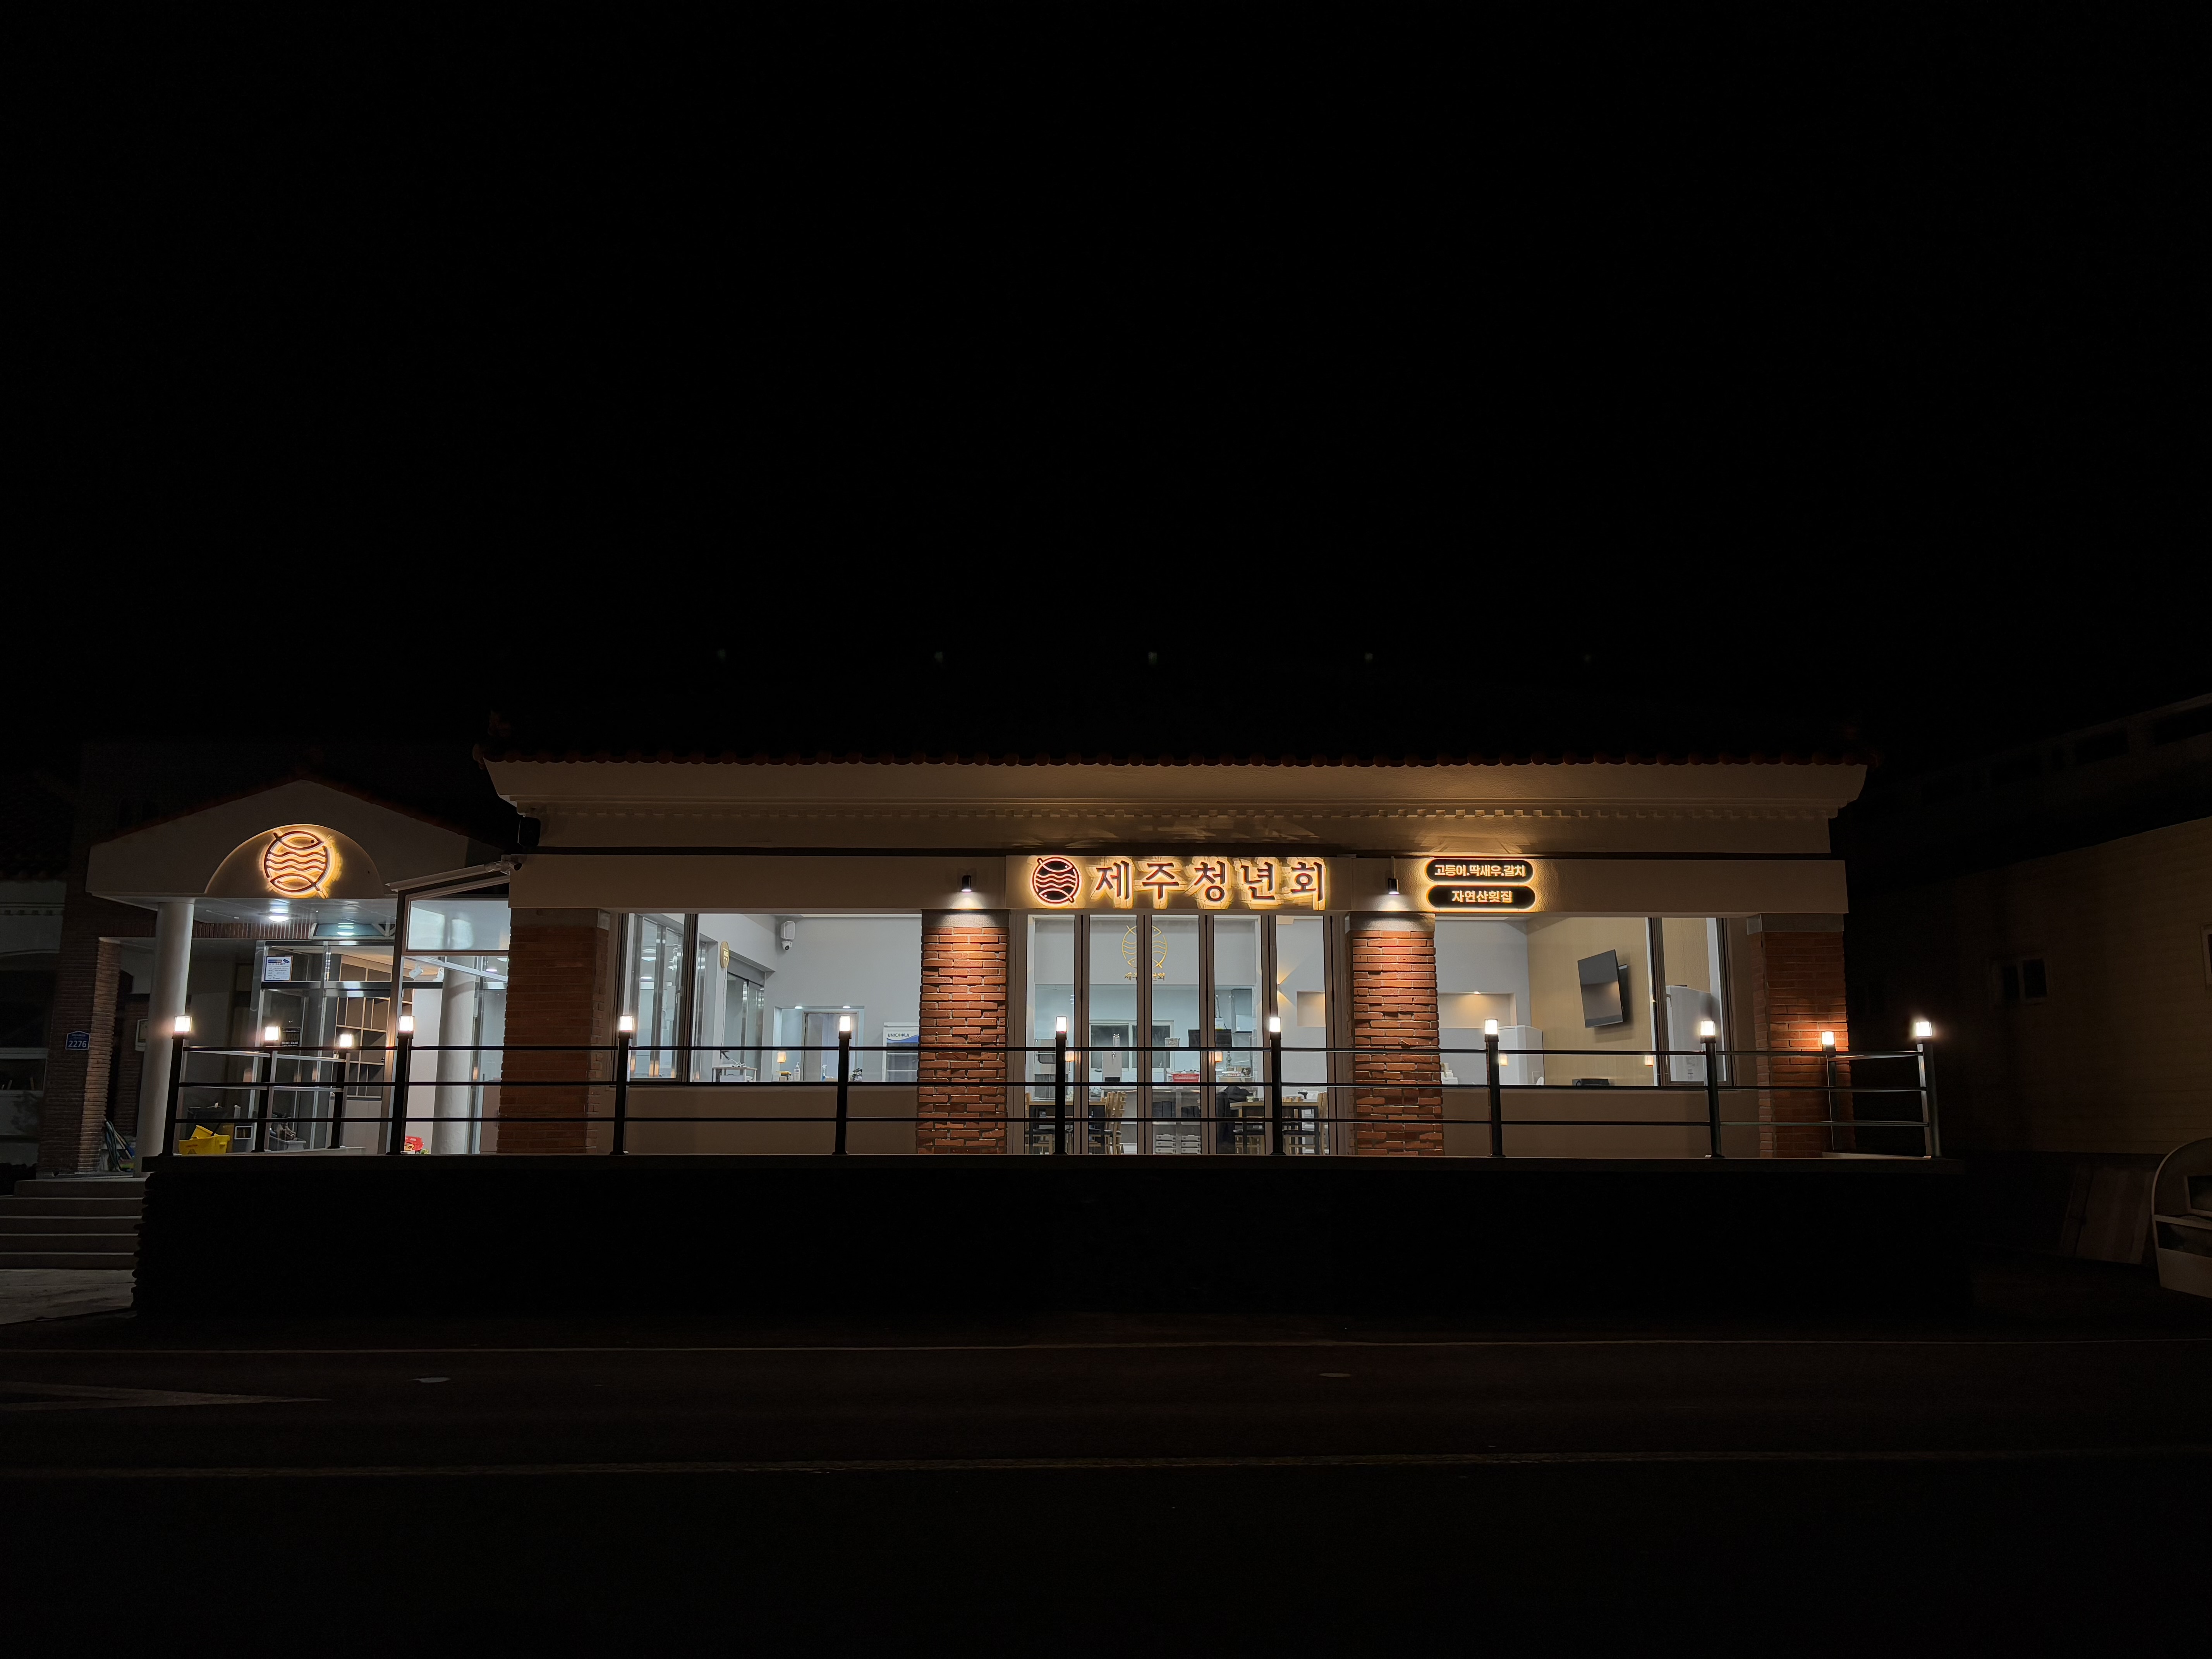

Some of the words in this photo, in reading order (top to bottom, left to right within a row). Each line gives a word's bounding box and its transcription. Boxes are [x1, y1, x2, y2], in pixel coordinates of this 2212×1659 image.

[1434, 865, 1526, 877] 고등어.딱새우.갈치
[1095, 860, 1323, 902] 제주청년회
[1452, 890, 1513, 903] 자연산횟집
